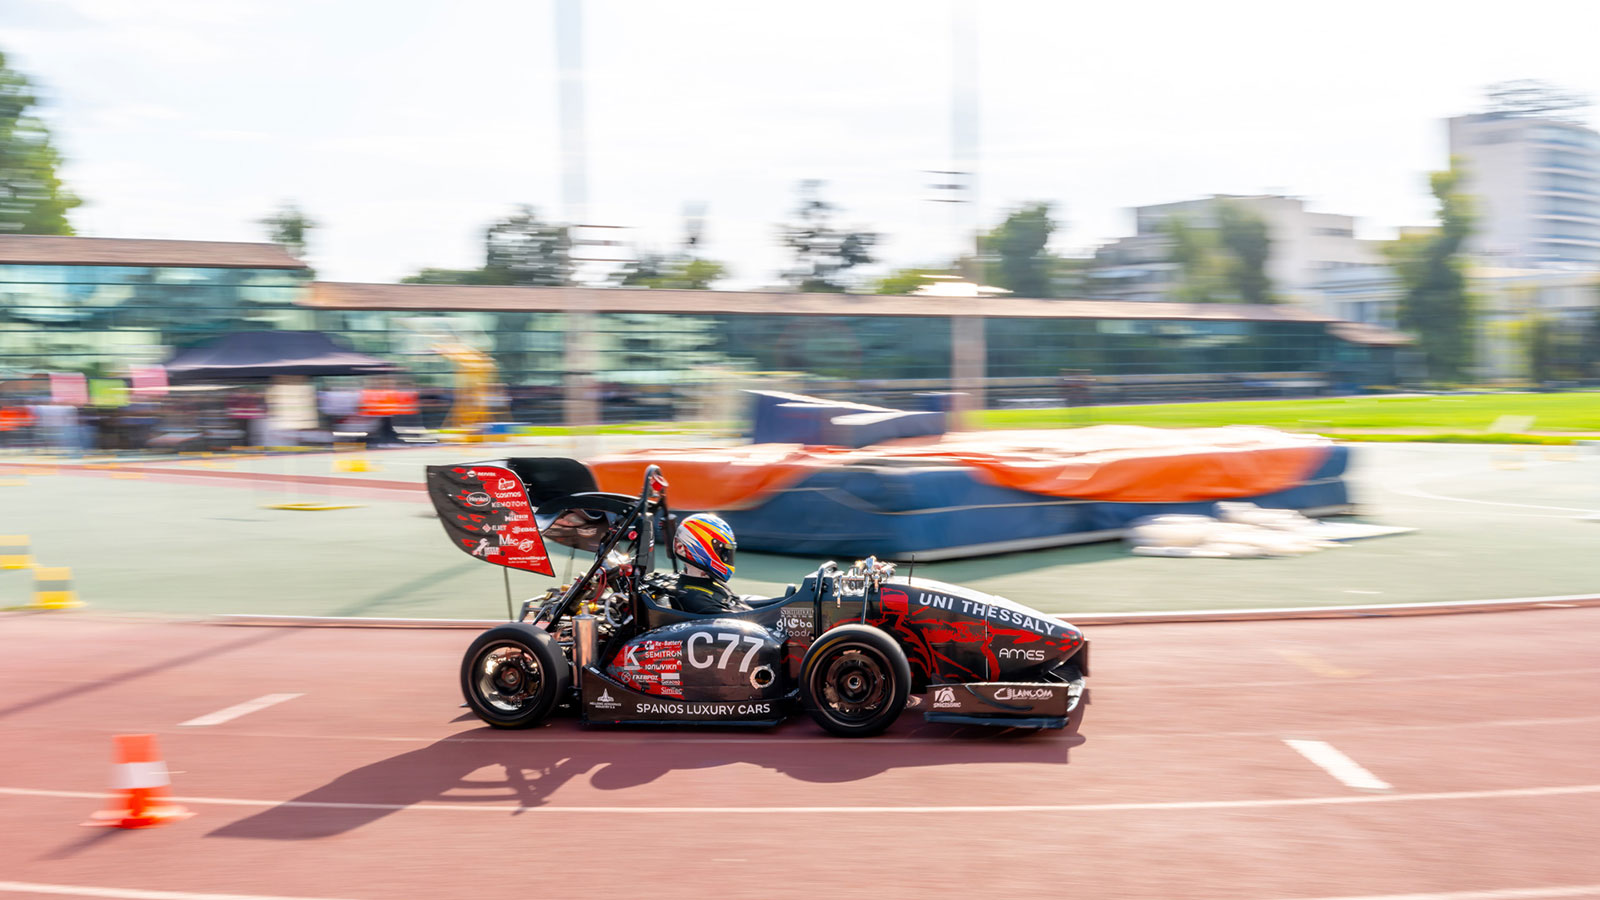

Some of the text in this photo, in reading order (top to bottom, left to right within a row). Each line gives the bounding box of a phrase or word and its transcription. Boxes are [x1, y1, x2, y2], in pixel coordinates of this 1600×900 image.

[919, 593, 1056, 636] UNI THESSALY
[776, 617, 813, 631] globa
[645, 650, 682, 659] SEMITRON
[687, 631, 764, 672] C77
[999, 648, 1045, 661] AMES
[636, 703, 771, 715] SPANOS LUXURY CARS
